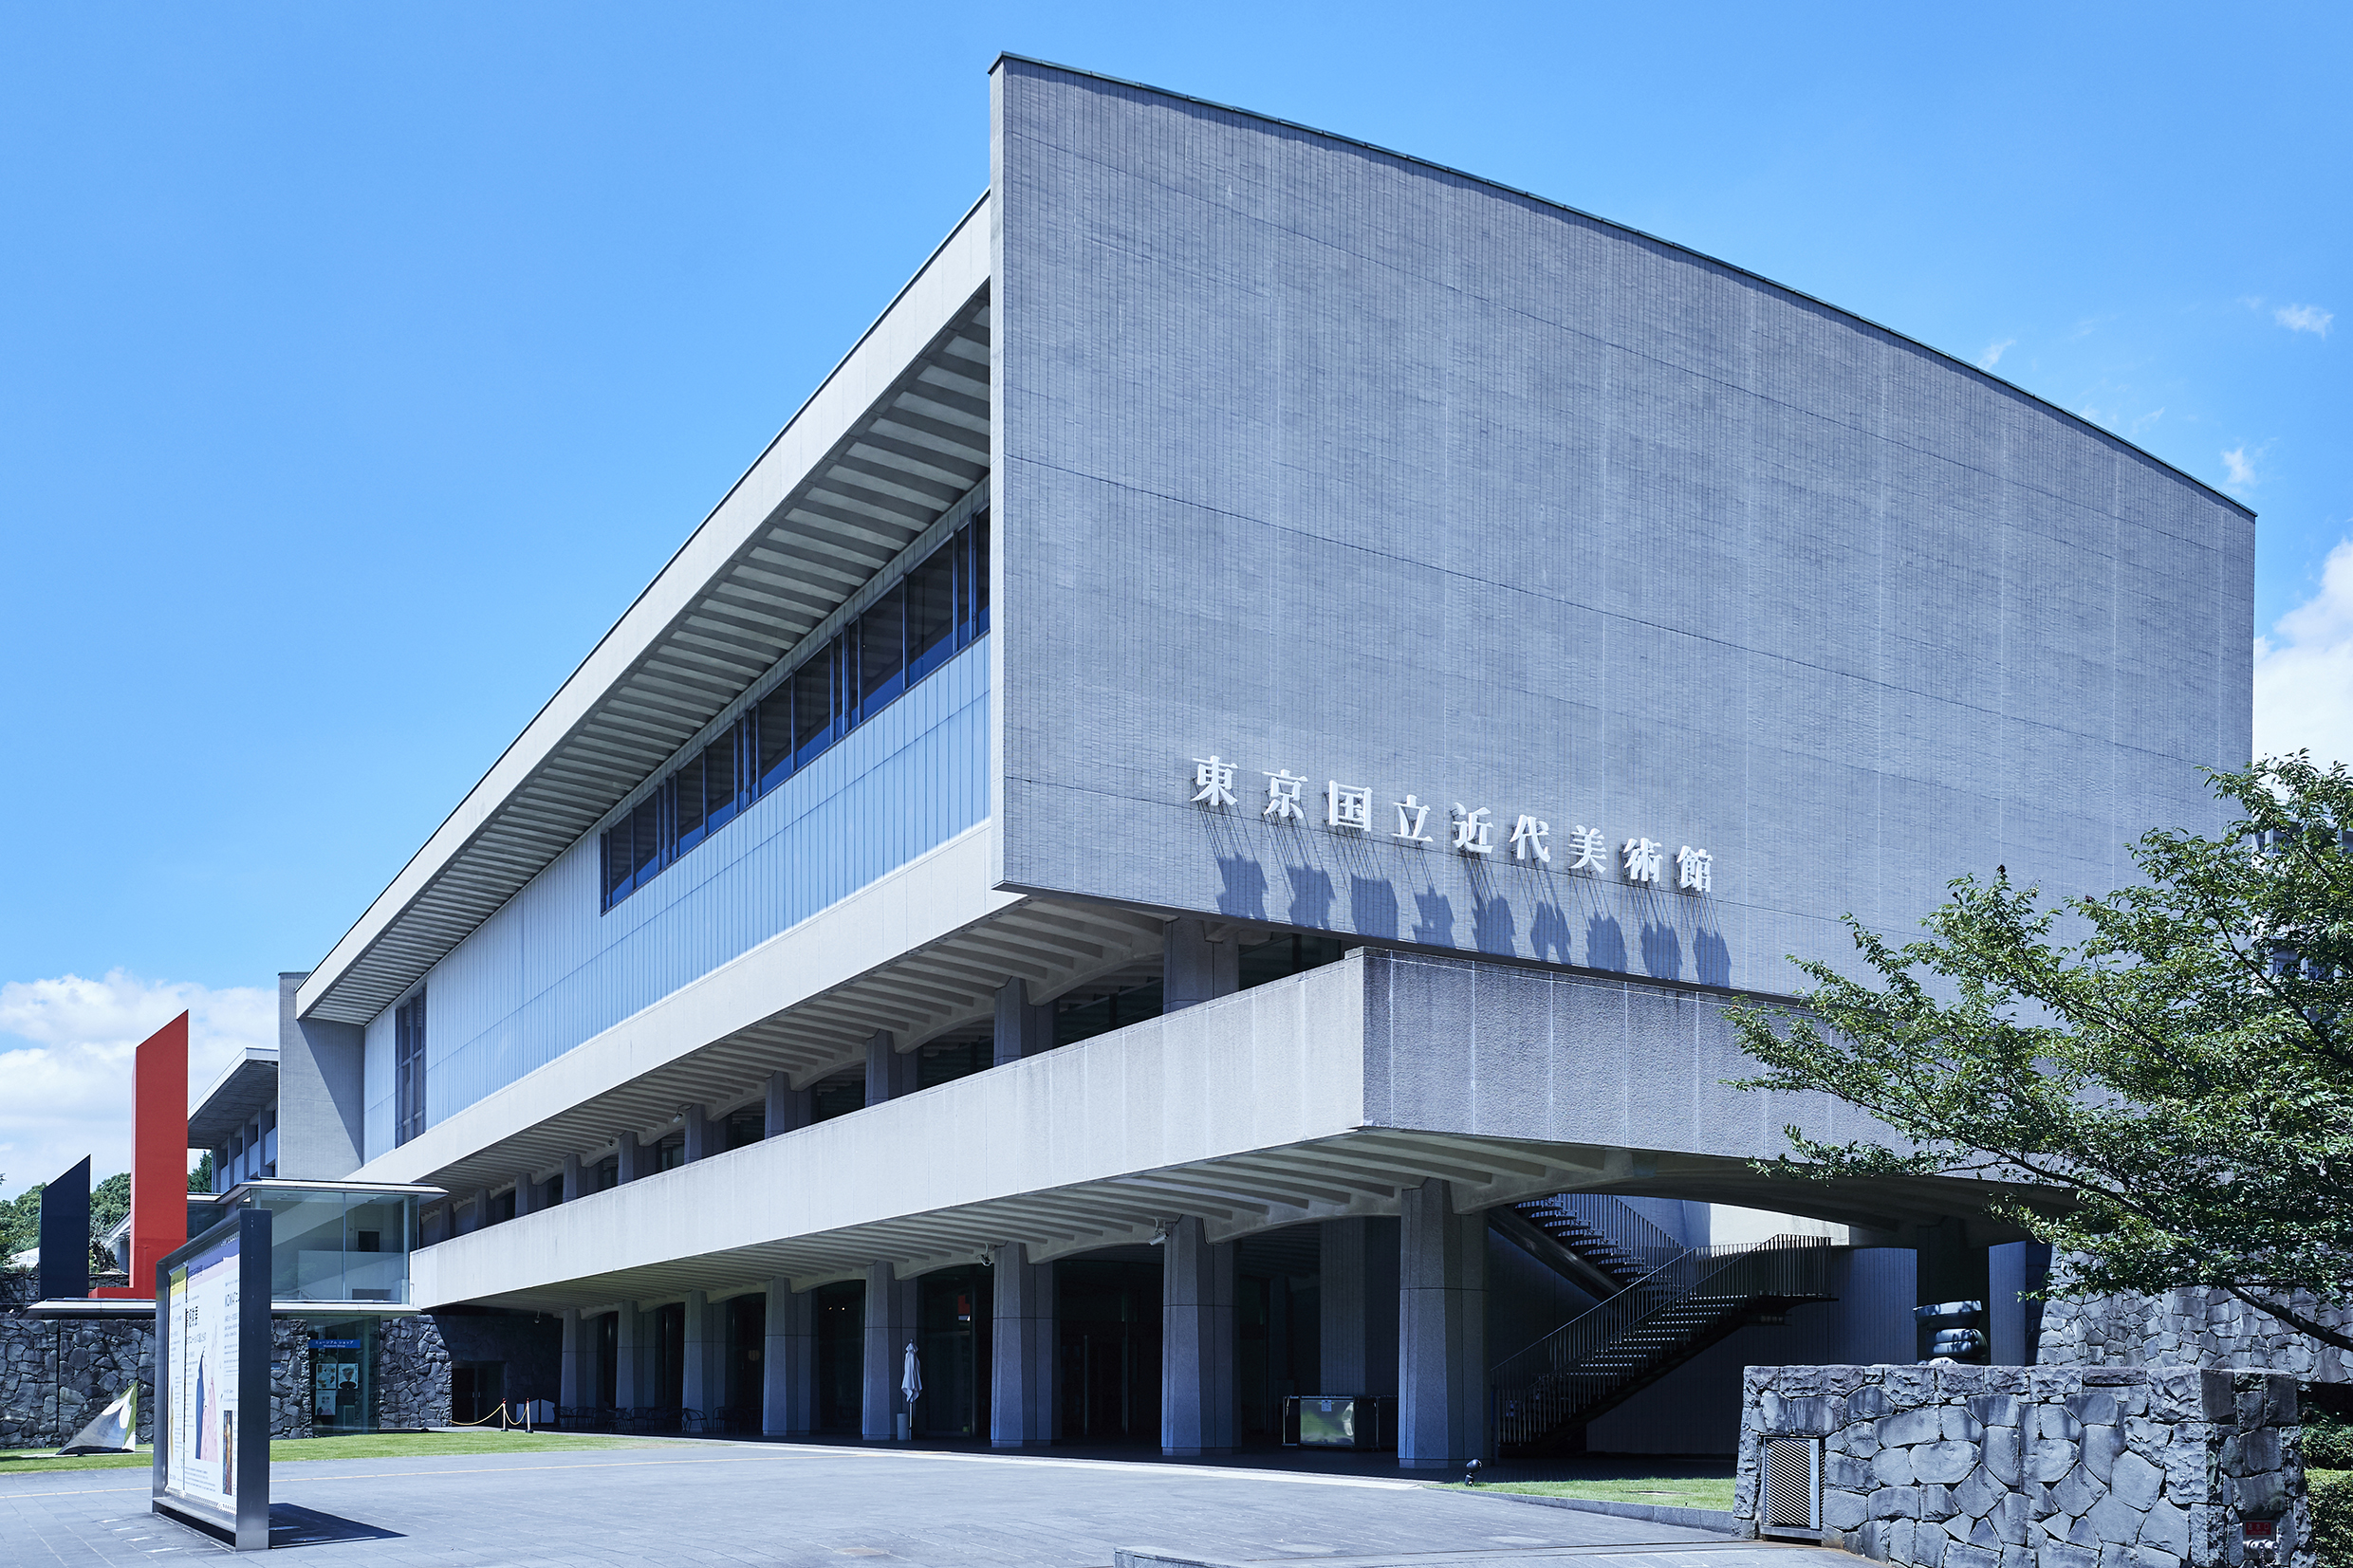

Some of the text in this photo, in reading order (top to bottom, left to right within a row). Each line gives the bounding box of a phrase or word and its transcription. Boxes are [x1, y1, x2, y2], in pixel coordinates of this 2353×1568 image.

[1191, 755, 1713, 893] 東京国立近代美術館
